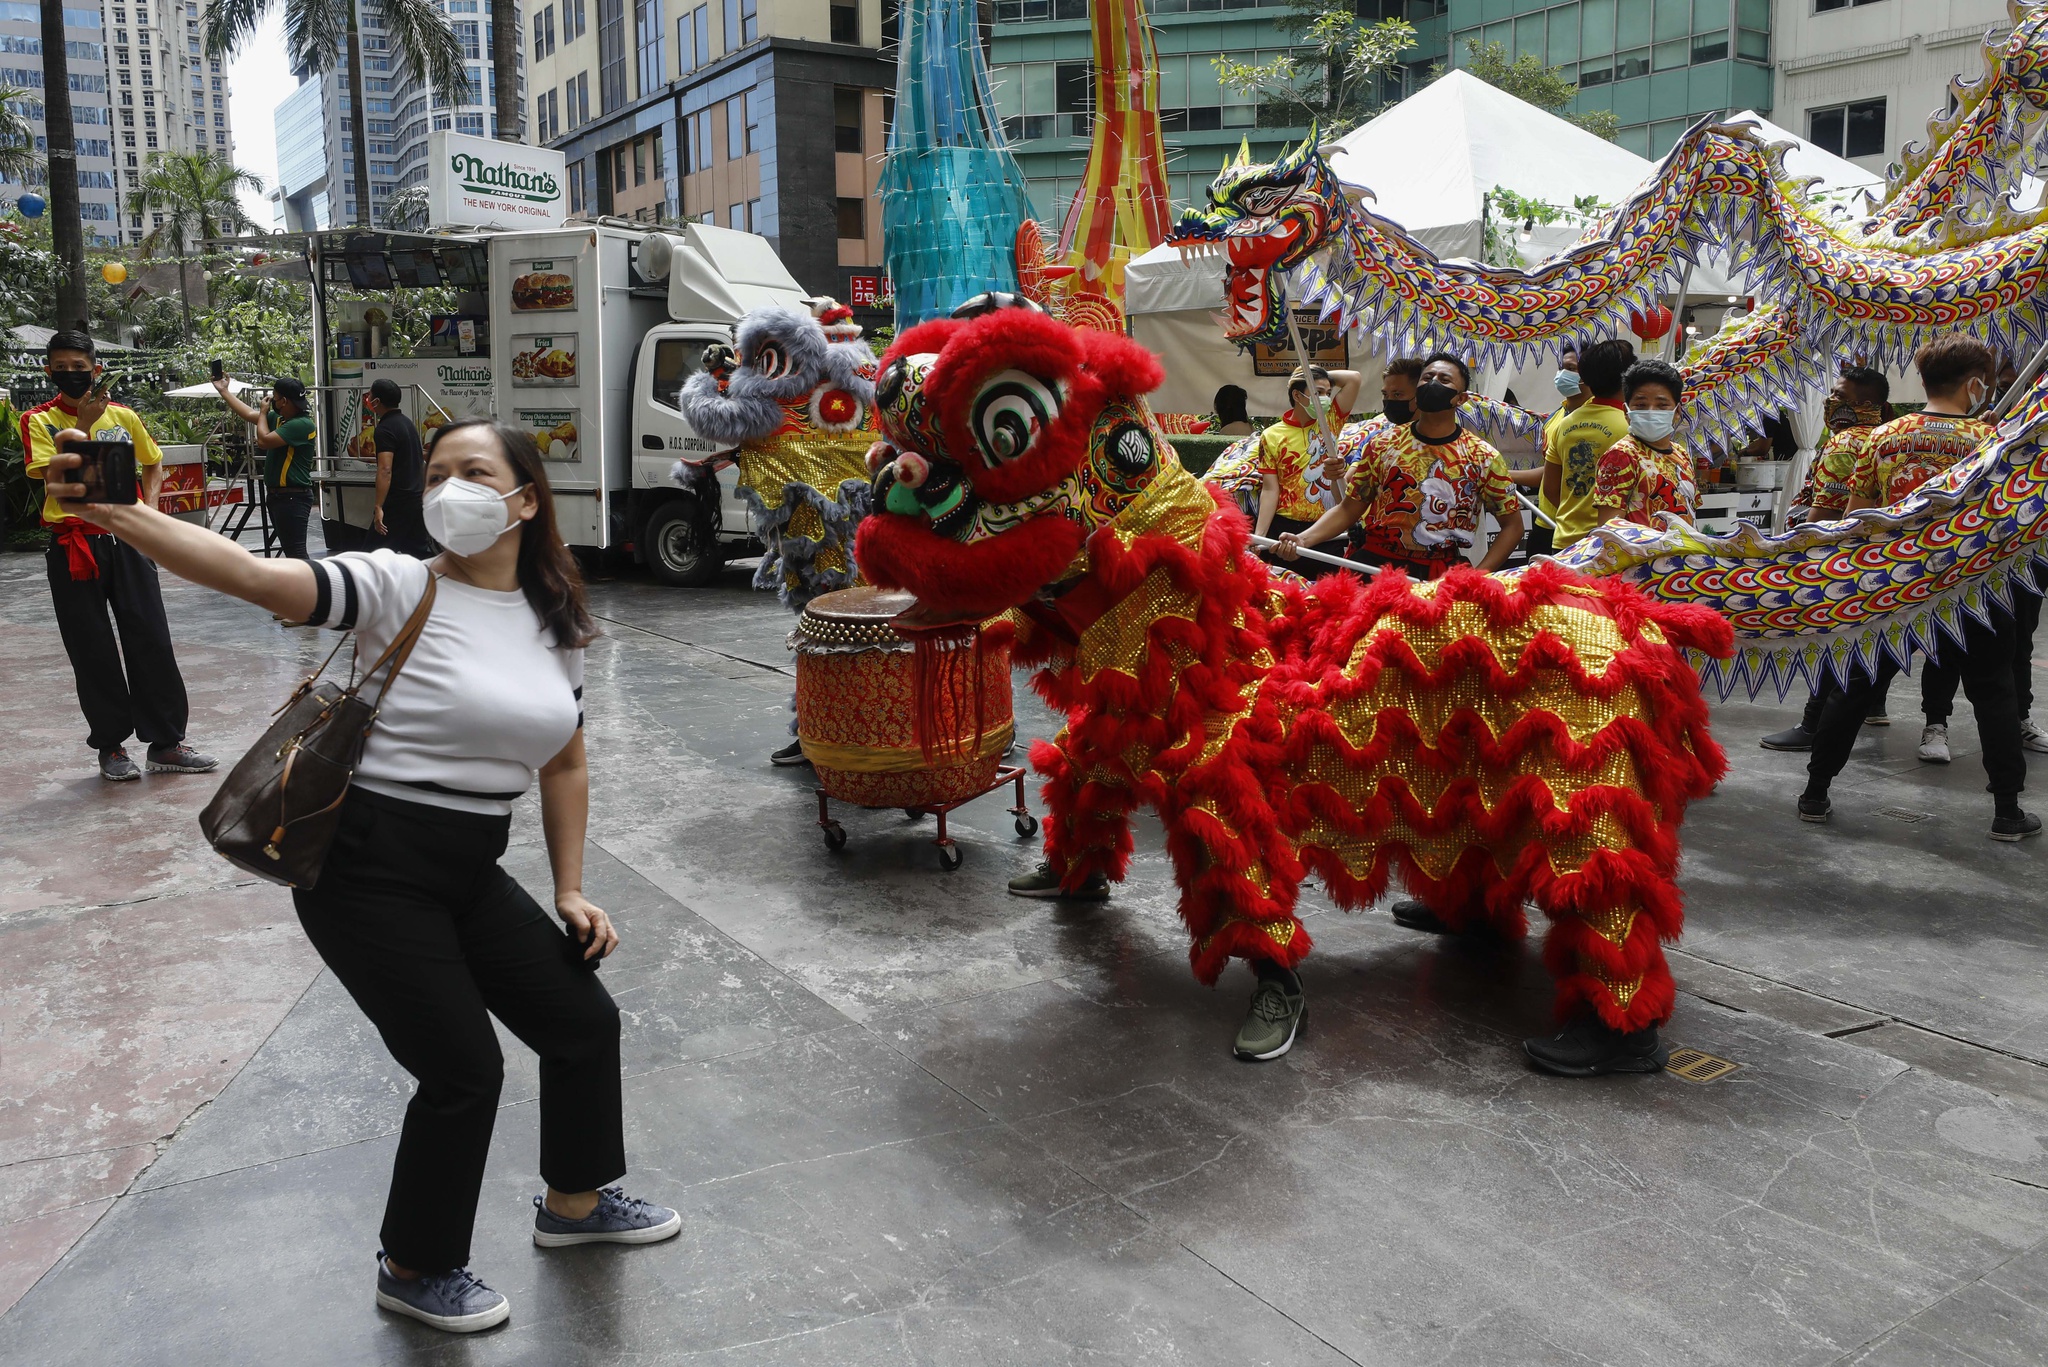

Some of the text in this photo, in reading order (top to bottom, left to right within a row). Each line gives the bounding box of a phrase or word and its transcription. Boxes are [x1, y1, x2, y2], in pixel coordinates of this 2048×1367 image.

[452, 153, 557, 195] Nathan's
[514, 164, 525, 172] Since
[490, 190, 526, 199] FAMOUS
[463, 198, 551, 218] THE NEW YORK ORIGINAL
[537, 339, 550, 347] Fries
[377, 362, 418, 370] NathansFamousPH
[438, 365, 491, 381] Nathan's
[685, 438, 717, 452] CORPORATION
[1914, 434, 1938, 454] LION
